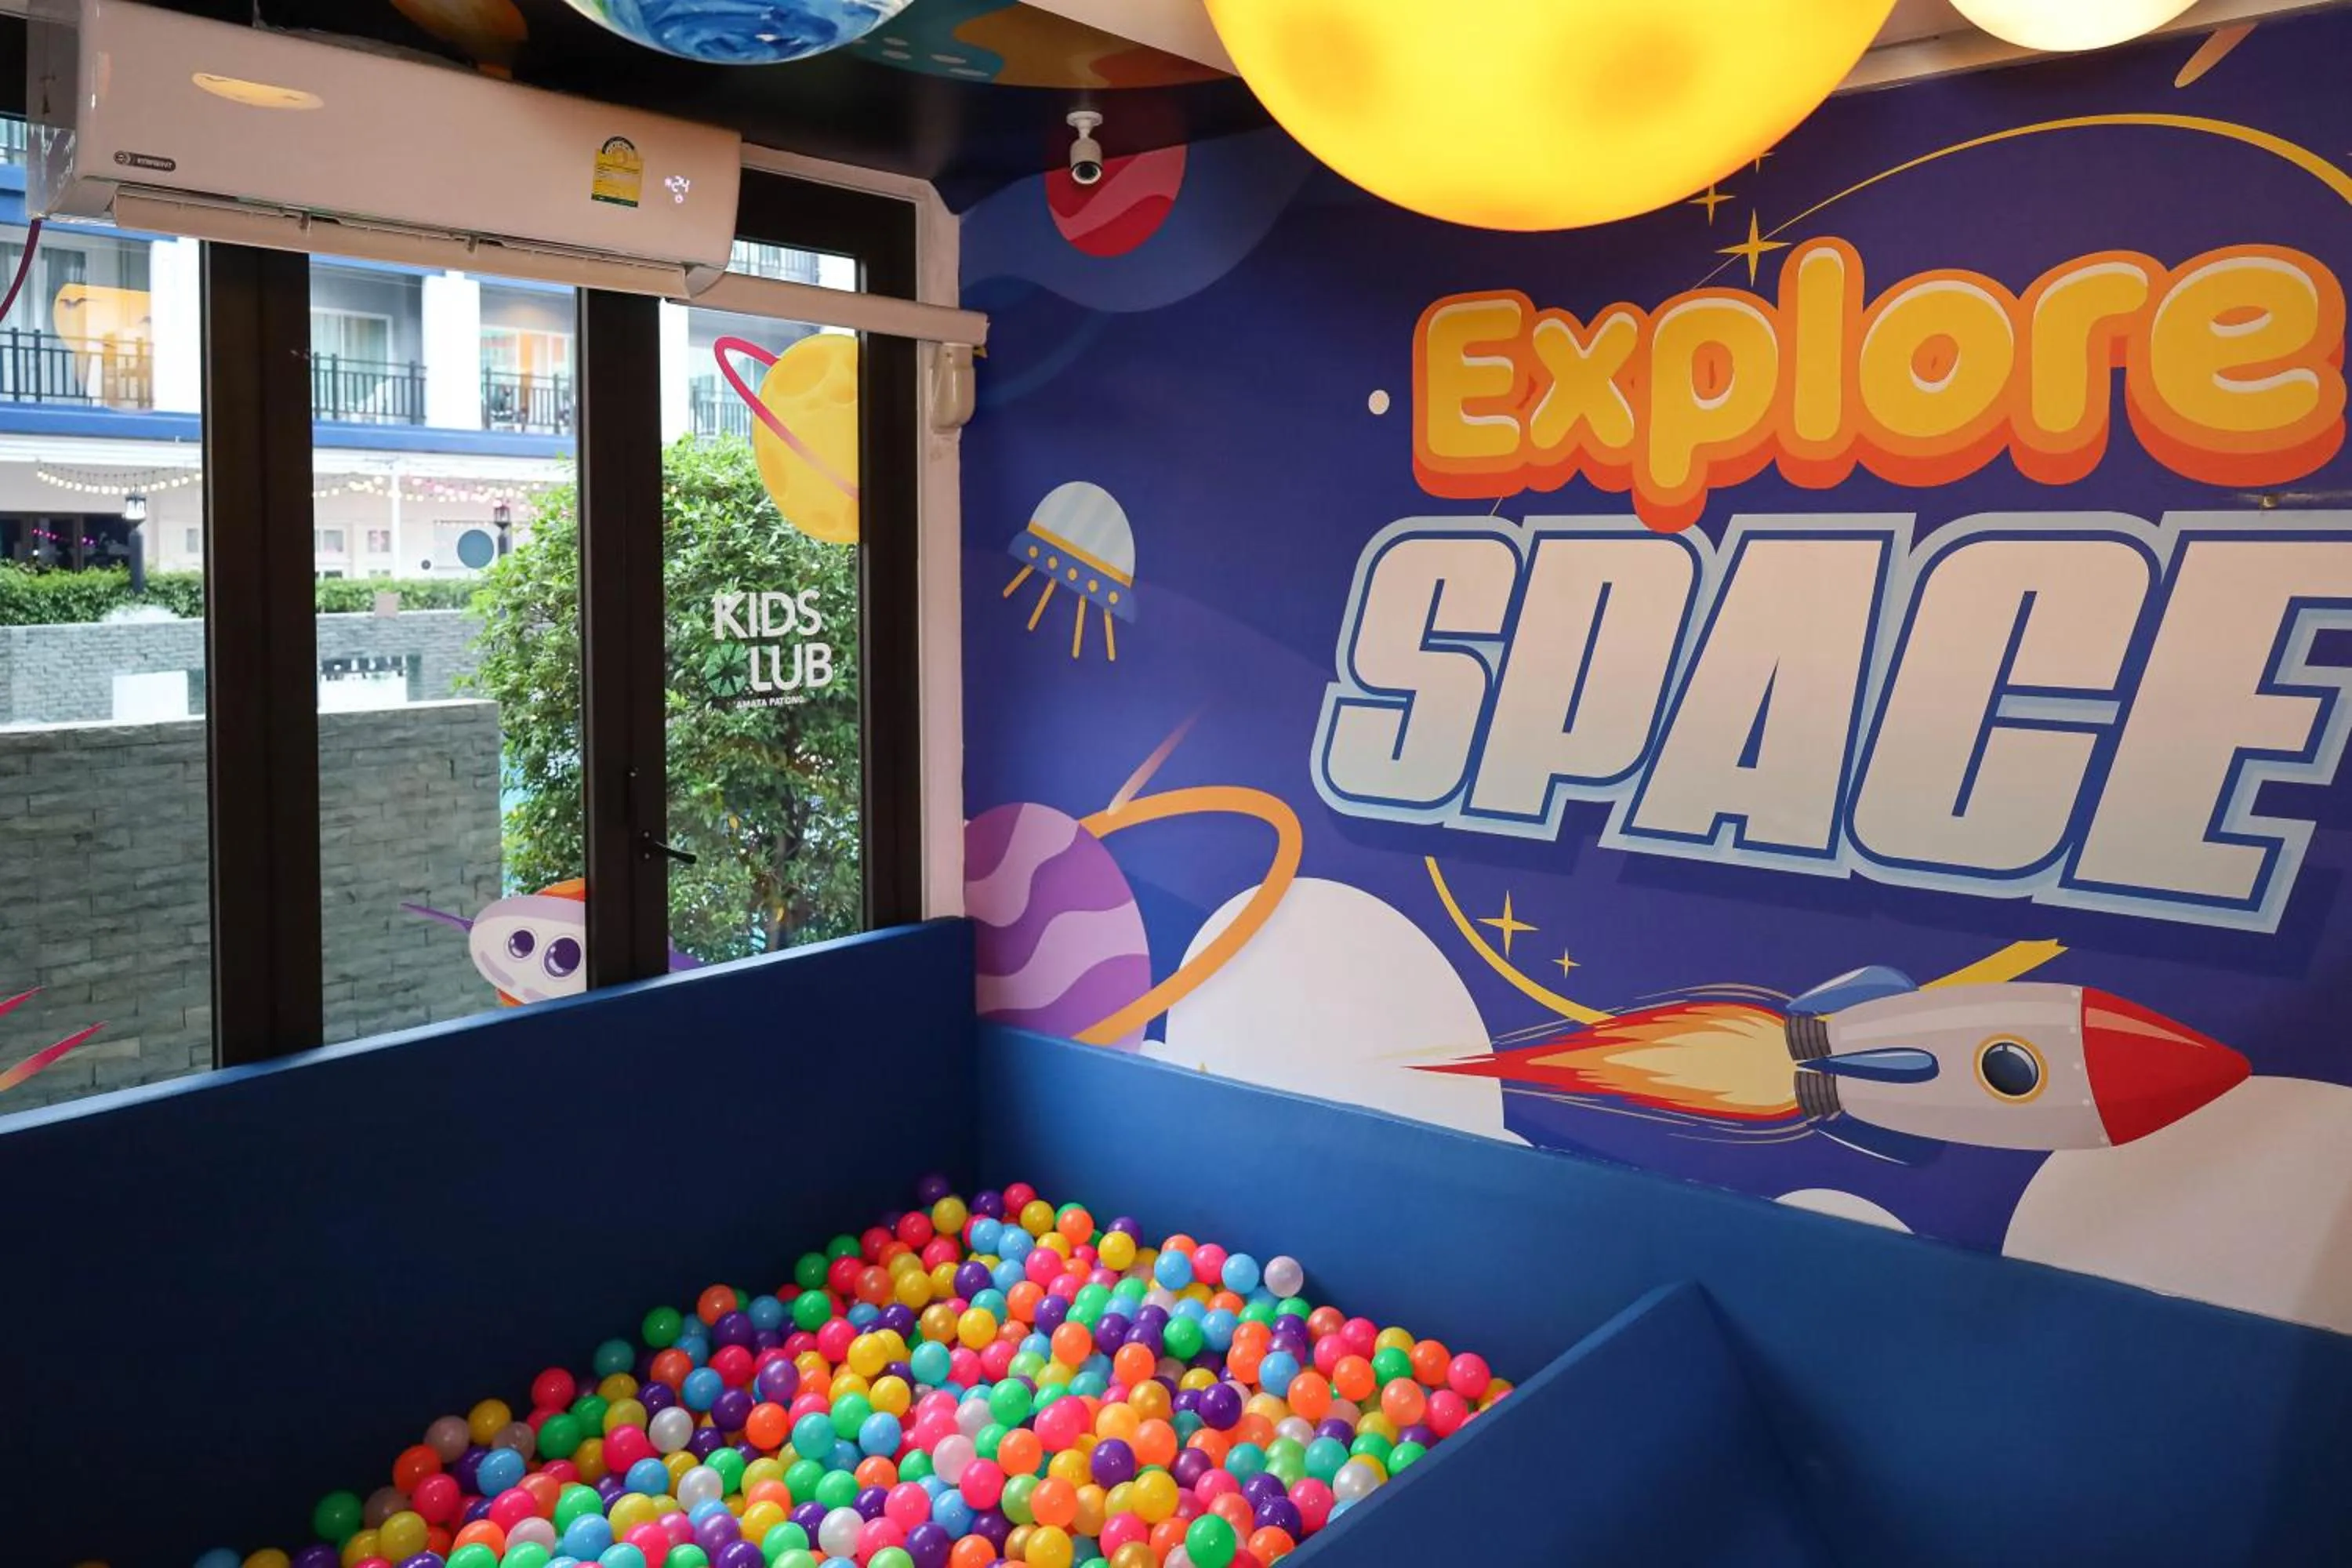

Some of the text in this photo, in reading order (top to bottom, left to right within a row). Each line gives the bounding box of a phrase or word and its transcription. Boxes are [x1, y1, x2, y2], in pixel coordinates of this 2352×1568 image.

[1412, 236, 2347, 534] Explore
[713, 589, 822, 641] KIDS
[1310, 510, 2352, 935] SPACE
